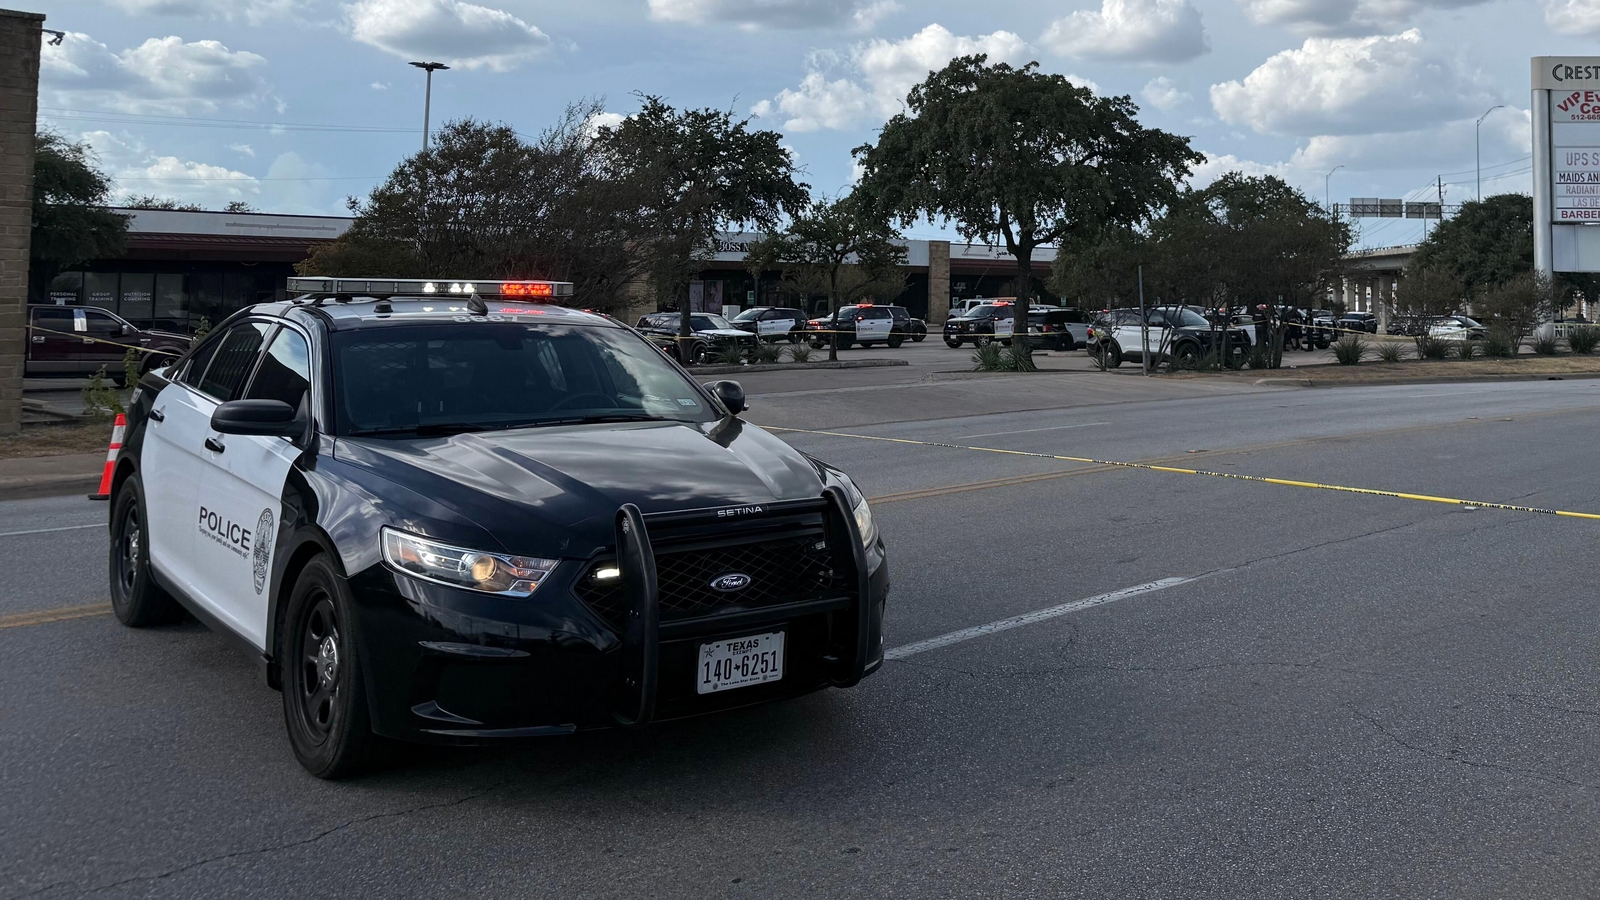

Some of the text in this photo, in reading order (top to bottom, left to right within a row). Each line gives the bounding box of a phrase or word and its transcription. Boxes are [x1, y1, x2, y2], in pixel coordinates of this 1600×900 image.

[1556, 91, 1580, 112] VIP
[1566, 152, 1600, 166] UPS S
[1558, 172, 1600, 182] MAIDS AN
[1572, 198, 1588, 207] LAS
[1561, 210, 1600, 219] BARBE
[717, 506, 763, 518] SETINA
[199, 506, 252, 551] POLICE
[720, 576, 744, 589] Ford
[726, 639, 759, 652] TEXAS
